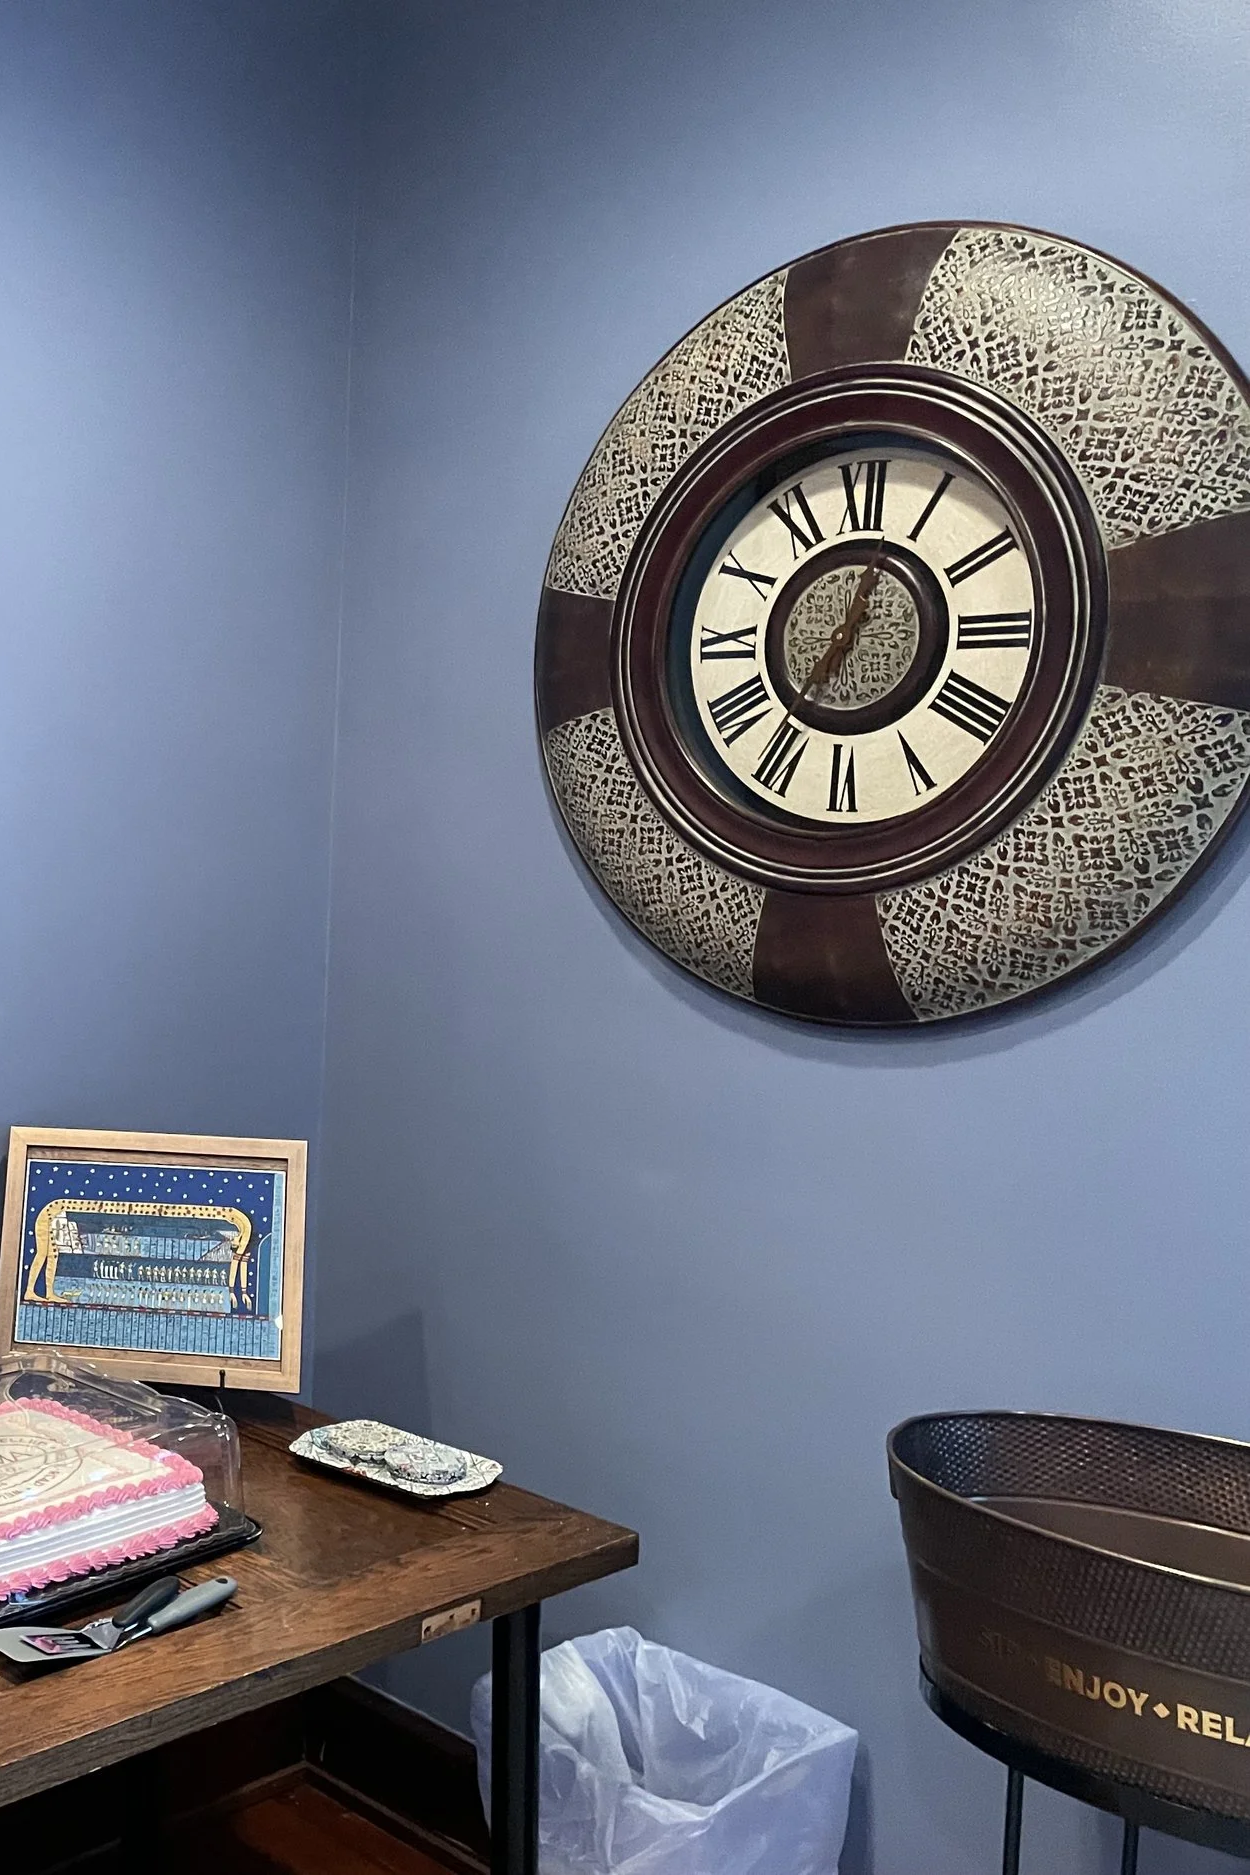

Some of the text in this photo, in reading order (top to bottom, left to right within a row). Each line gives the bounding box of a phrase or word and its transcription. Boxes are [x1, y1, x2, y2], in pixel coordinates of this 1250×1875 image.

[767, 482, 826, 561] XI
[837, 460, 891, 535] XII
[908, 472, 956, 542] I
[718, 551, 778, 602] X
[943, 525, 1020, 588] II
[701, 624, 758, 664] IX
[957, 609, 1032, 650] III
[707, 672, 774, 748] VIII
[928, 669, 1013, 746] IIII
[826, 744, 858, 813] VI
[897, 729, 937, 796] V
[1044, 1655, 1250, 1748] ENJOY REL
